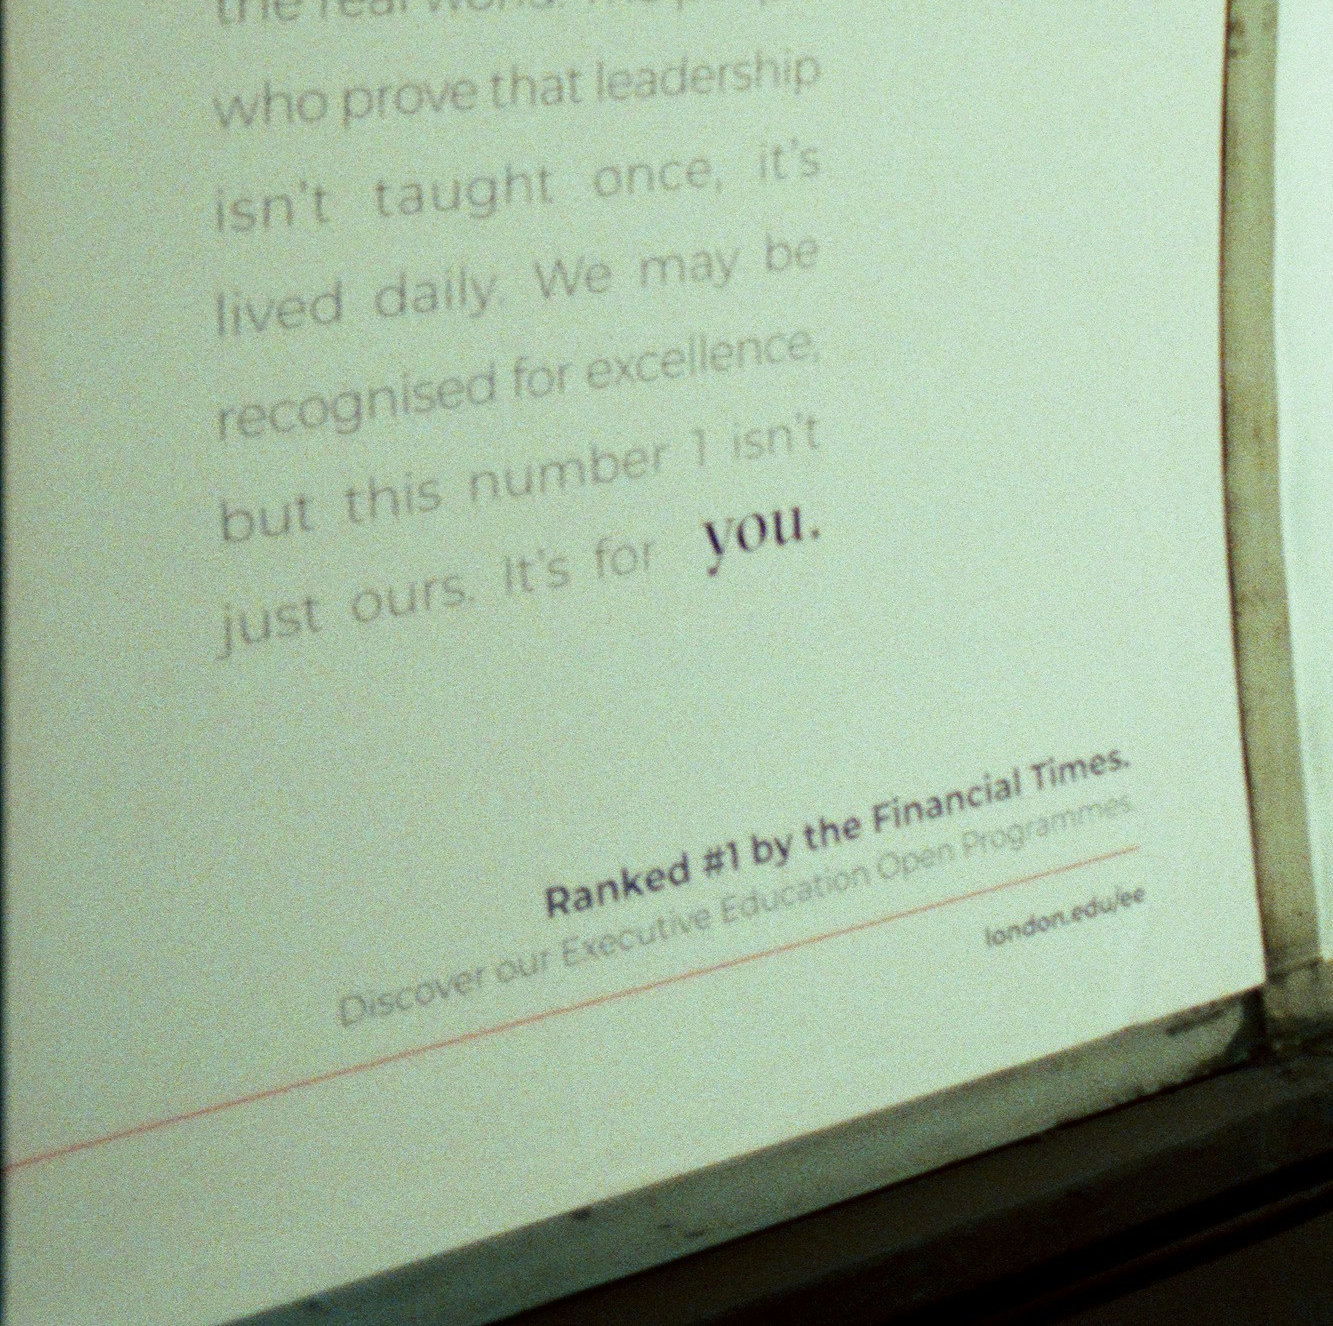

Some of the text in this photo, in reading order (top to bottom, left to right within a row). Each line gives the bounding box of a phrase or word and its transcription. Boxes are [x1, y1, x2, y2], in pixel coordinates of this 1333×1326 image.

[212, 51, 823, 131] who prove that leadership
[215, 138, 821, 233] isn't taught once, it's
[215, 279, 344, 338] lived
[532, 256, 613, 301] We
[639, 249, 739, 290] may
[764, 234, 820, 274] be
[216, 362, 498, 442] recognised
[511, 355, 570, 399] for
[218, 493, 314, 547] but
[343, 476, 443, 526] this
[468, 443, 668, 504] number
[732, 413, 820, 460] isn't
[216, 503, 823, 662] just ours. It's for you.
[543, 749, 1130, 920] Ranked #1 by the Financial Times.
[337, 966, 486, 1029] Discover
[494, 949, 549, 985] our
[560, 908, 711, 968] Executive
[720, 865, 870, 925] Education
[875, 843, 954, 881] Open
[983, 886, 1146, 948] london.edu/ee
